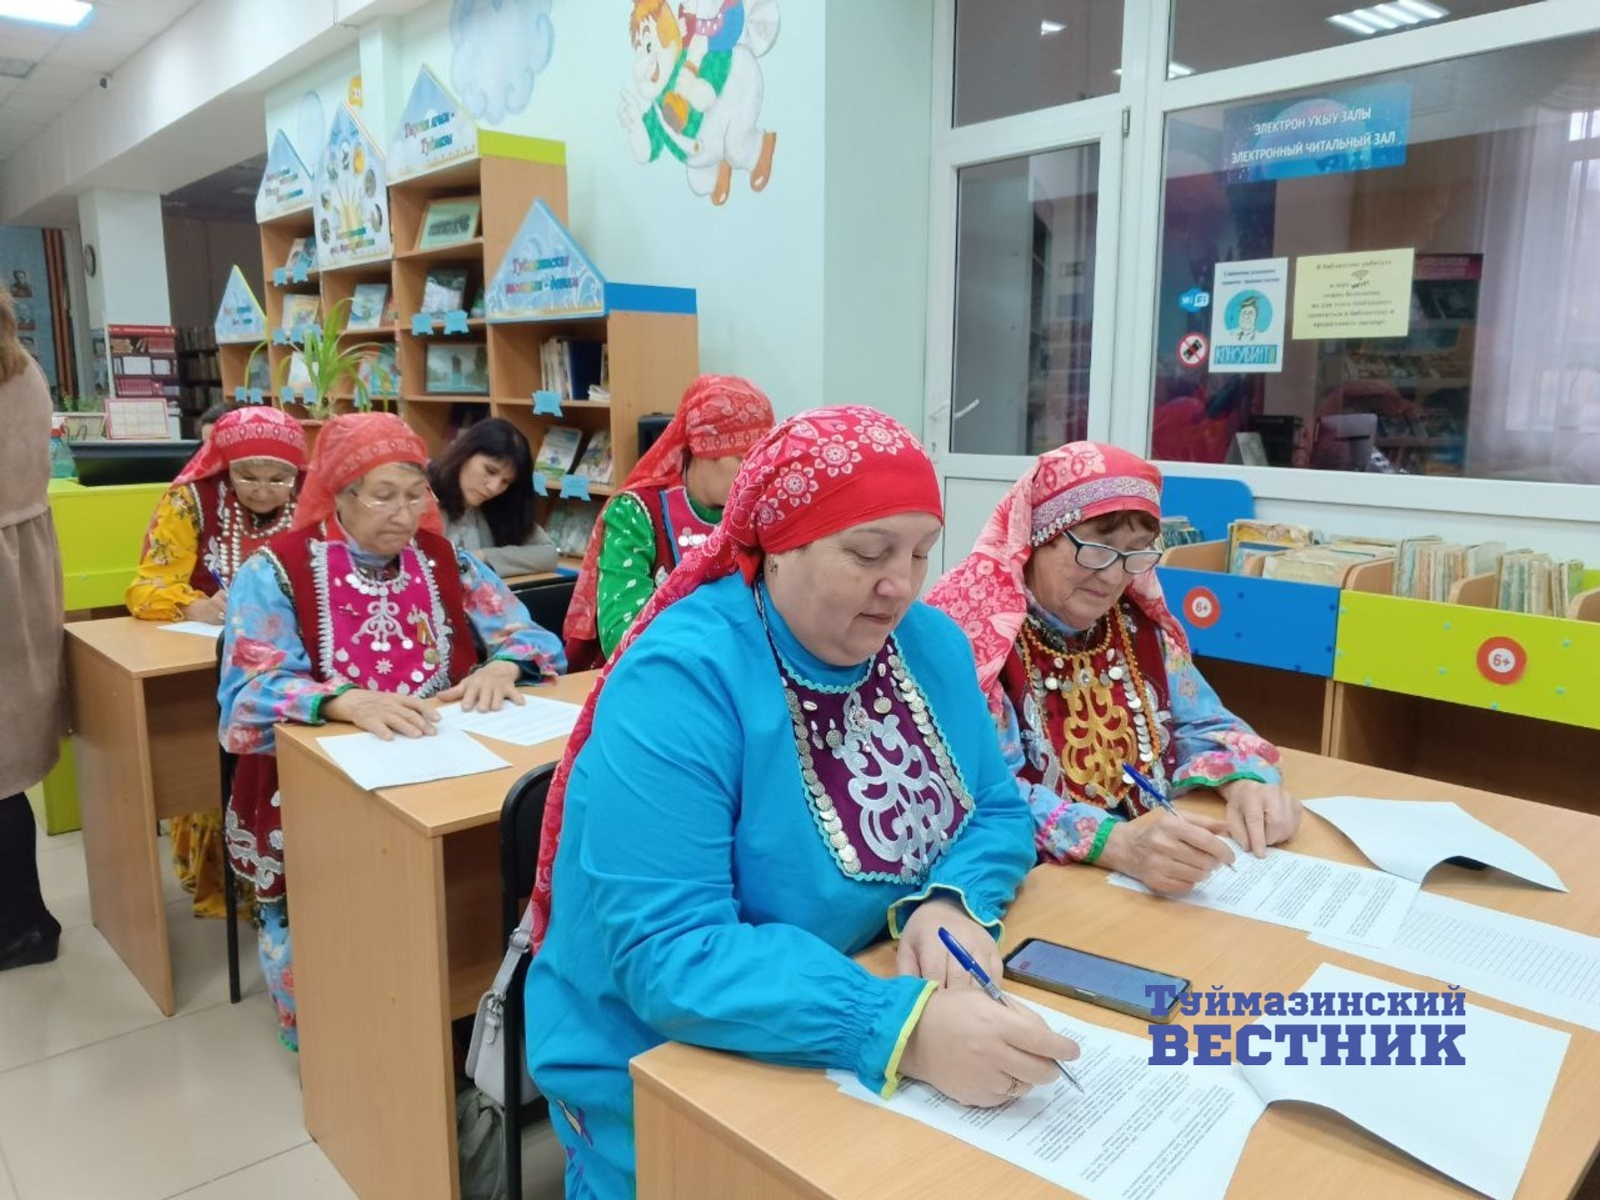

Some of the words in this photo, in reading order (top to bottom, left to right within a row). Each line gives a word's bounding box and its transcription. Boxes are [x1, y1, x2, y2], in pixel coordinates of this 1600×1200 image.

[1254, 117, 1306, 136] ЭЛЕКТРОН
[1340, 107, 1372, 123] ЗАЛЫ
[1231, 143, 1303, 165] ЭЛЕКТРОННЫЙ
[1305, 133, 1371, 155] ЧИТАЛЬНЫЙ
[1373, 131, 1396, 146] ЗАЛ
[1196, 601, 1208, 613] 6+
[1492, 653, 1511, 667] 6+
